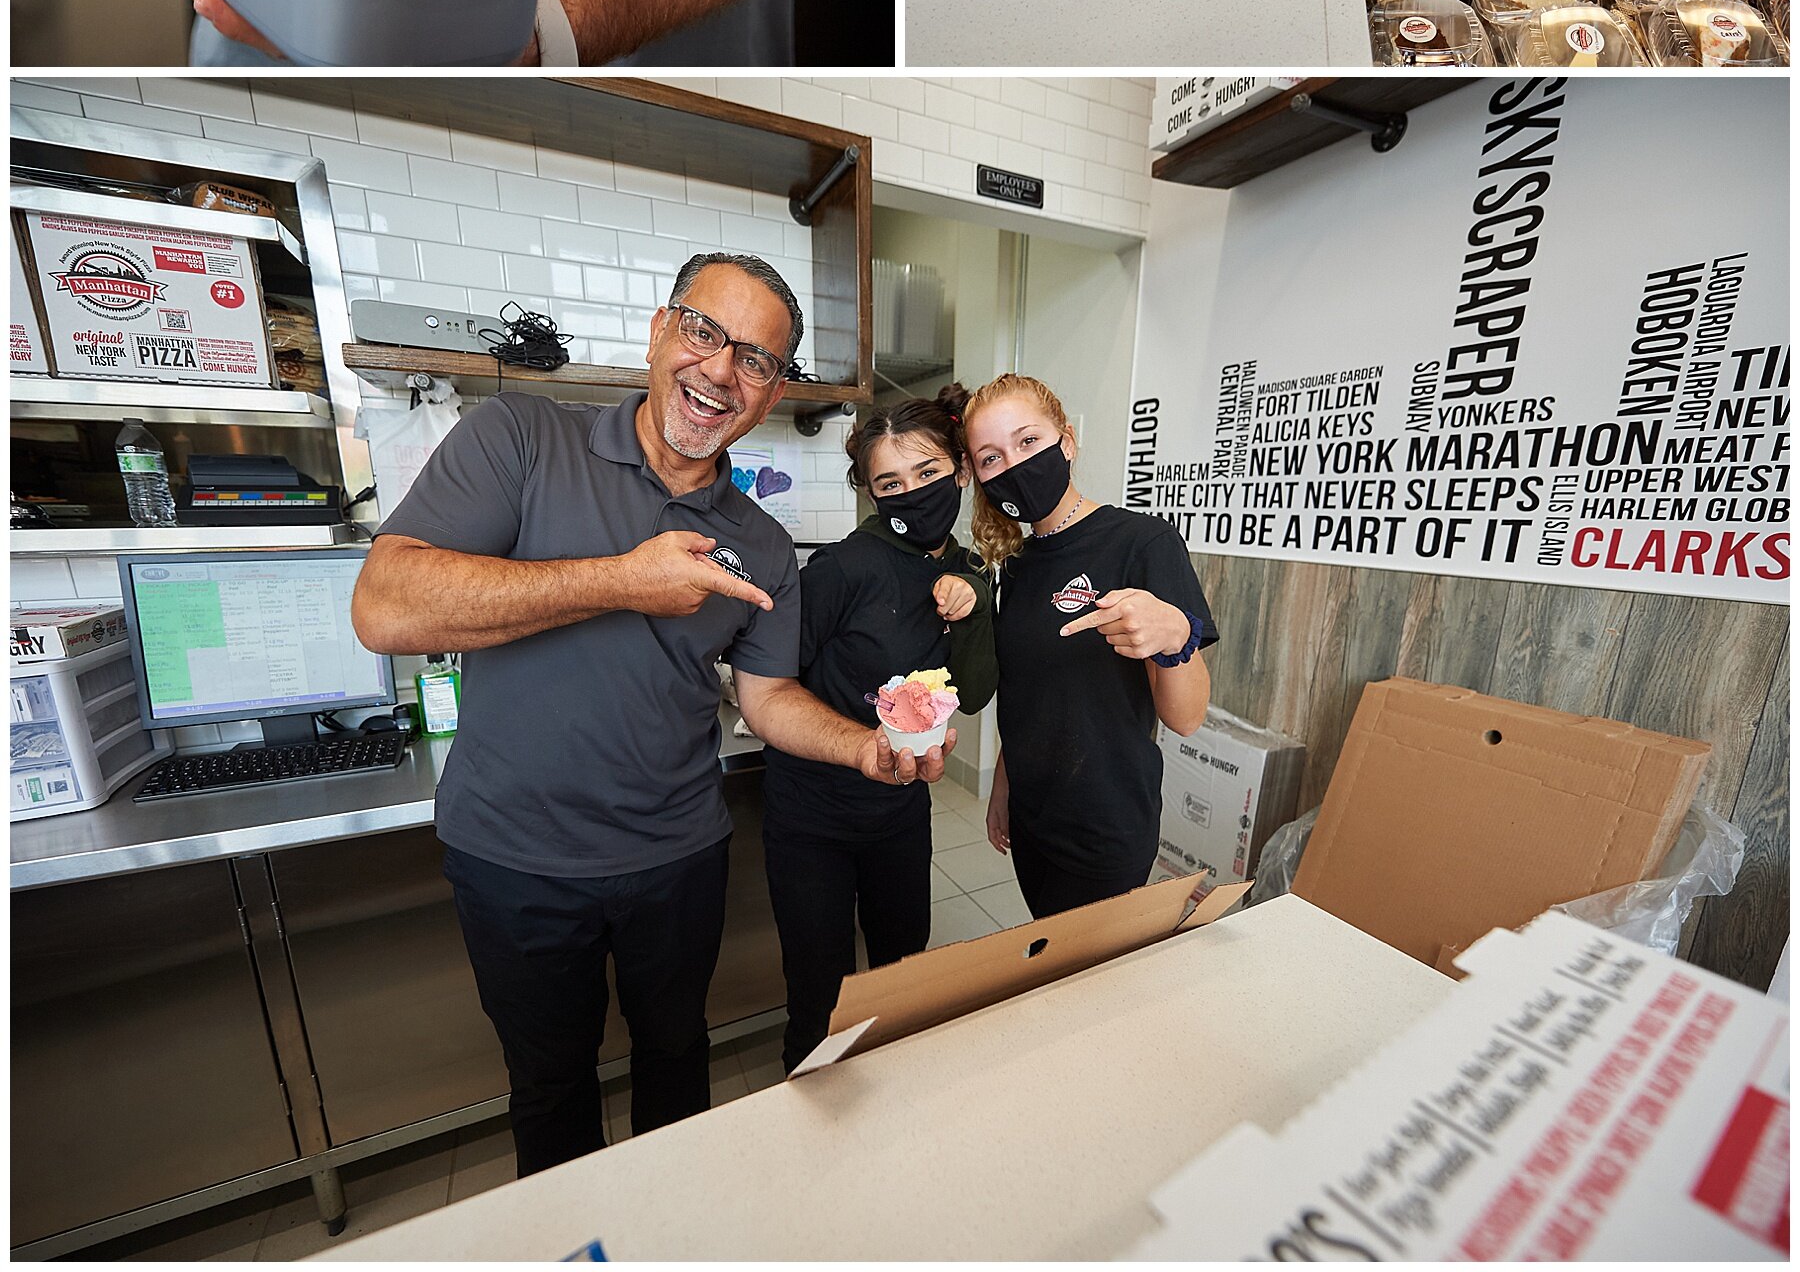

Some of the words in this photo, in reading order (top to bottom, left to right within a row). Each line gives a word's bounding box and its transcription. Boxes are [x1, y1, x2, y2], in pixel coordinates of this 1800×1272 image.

[1167, 106, 1193, 134] COME
[1215, 77, 1256, 107] HUNGRY
[1171, 77, 1197, 105] COME
[208, 184, 234, 198] CLUB
[986, 171, 1036, 192] EMPLOYEES
[1000, 185, 1023, 198] ONLY
[59, 247, 73, 264] Award
[110, 242, 125, 252] York
[126, 248, 142, 261] Style
[155, 250, 203, 259] MANHATTAN
[1441, 77, 1569, 401] SKYSCRAPER
[73, 279, 149, 298] Manhattan
[100, 294, 127, 304] Pizza
[216, 289, 236, 300] #1
[77, 300, 151, 322] www.manhattanpizza.com
[1691, 252, 1749, 357] LAGUARDIA
[73, 330, 125, 346] original
[75, 344, 98, 356] NEW
[100, 346, 127, 357] YORK
[136, 336, 194, 349] MANHATTAN
[1617, 262, 1705, 418] HOBOKEN
[88, 355, 119, 367] TASTE
[138, 348, 197, 368] PIZZA
[203, 362, 227, 372] COME
[227, 363, 257, 374] HUNGRY
[1236, 360, 1257, 431] HALLOWEEN
[1257, 378, 1298, 395] MADISON
[1299, 372, 1337, 389] SQUARE
[1340, 366, 1384, 383] GARDEN
[1674, 361, 1721, 431] AIRPORT
[1216, 363, 1241, 436] CENTRAL
[1255, 392, 1302, 419] FORT
[1306, 381, 1380, 413] TILDEN
[1405, 360, 1440, 433] SUBWAY
[1438, 396, 1555, 428] YONKERS
[1252, 417, 1311, 444] ALICIA
[1317, 411, 1375, 439] KEYS
[1126, 398, 1160, 508] GOTHAM
[1212, 440, 1232, 479] PARK
[1231, 435, 1249, 478] PARADE
[1249, 444, 1309, 477] NEW
[1316, 438, 1398, 475] YORK
[1406, 419, 1662, 472] MARATHON
[1663, 433, 1764, 464] MEAT
[1156, 463, 1210, 482] HARLEM
[1584, 468, 1682, 493] UPPER
[1694, 464, 1790, 492] WEST
[1155, 484, 1186, 508] THE
[1192, 483, 1236, 508] CITY
[1242, 481, 1299, 509] THAT
[1304, 479, 1396, 510] NEVER
[1404, 475, 1543, 512] SLEEPS
[1548, 474, 1579, 514] ELLIS
[1580, 497, 1698, 521] HARLEM
[1203, 513, 1232, 544] TO
[1239, 514, 1276, 547] BE
[1282, 515, 1301, 549] A
[1312, 515, 1405, 556] PART
[1415, 518, 1472, 559] OF
[1481, 519, 1533, 564] IT
[1537, 516, 1570, 566] ISLAND
[1571, 527, 1790, 580] CLARKS
[1179, 743, 1199, 760] COME
[1210, 756, 1239, 777] HUNGRY
